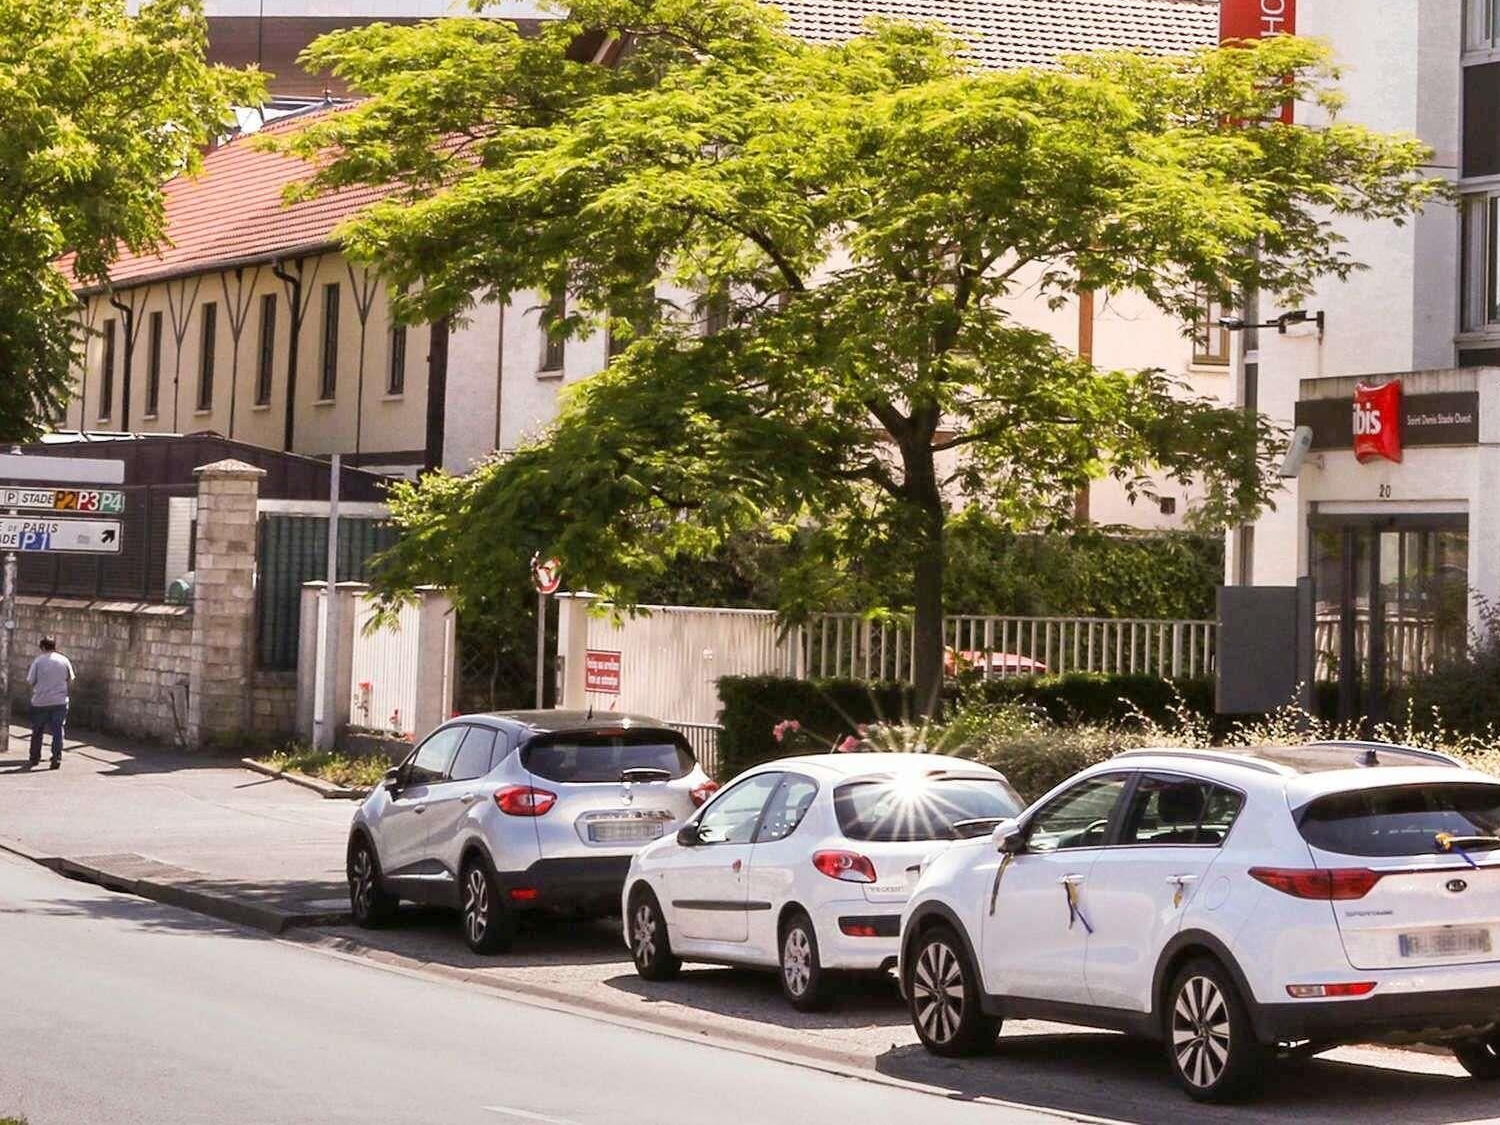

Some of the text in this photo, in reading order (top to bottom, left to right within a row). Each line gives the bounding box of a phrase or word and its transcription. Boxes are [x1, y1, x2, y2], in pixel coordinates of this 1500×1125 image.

[1352, 402, 1382, 435] ibis
[1379, 484, 1391, 498] 20
[22, 493, 54, 504] STADE
[56, 491, 77, 509] P2
[77, 492, 100, 510] P3
[100, 493, 122, 511] P4
[22, 522, 58, 533] PARIS
[0, 533, 48, 550] DE P1
